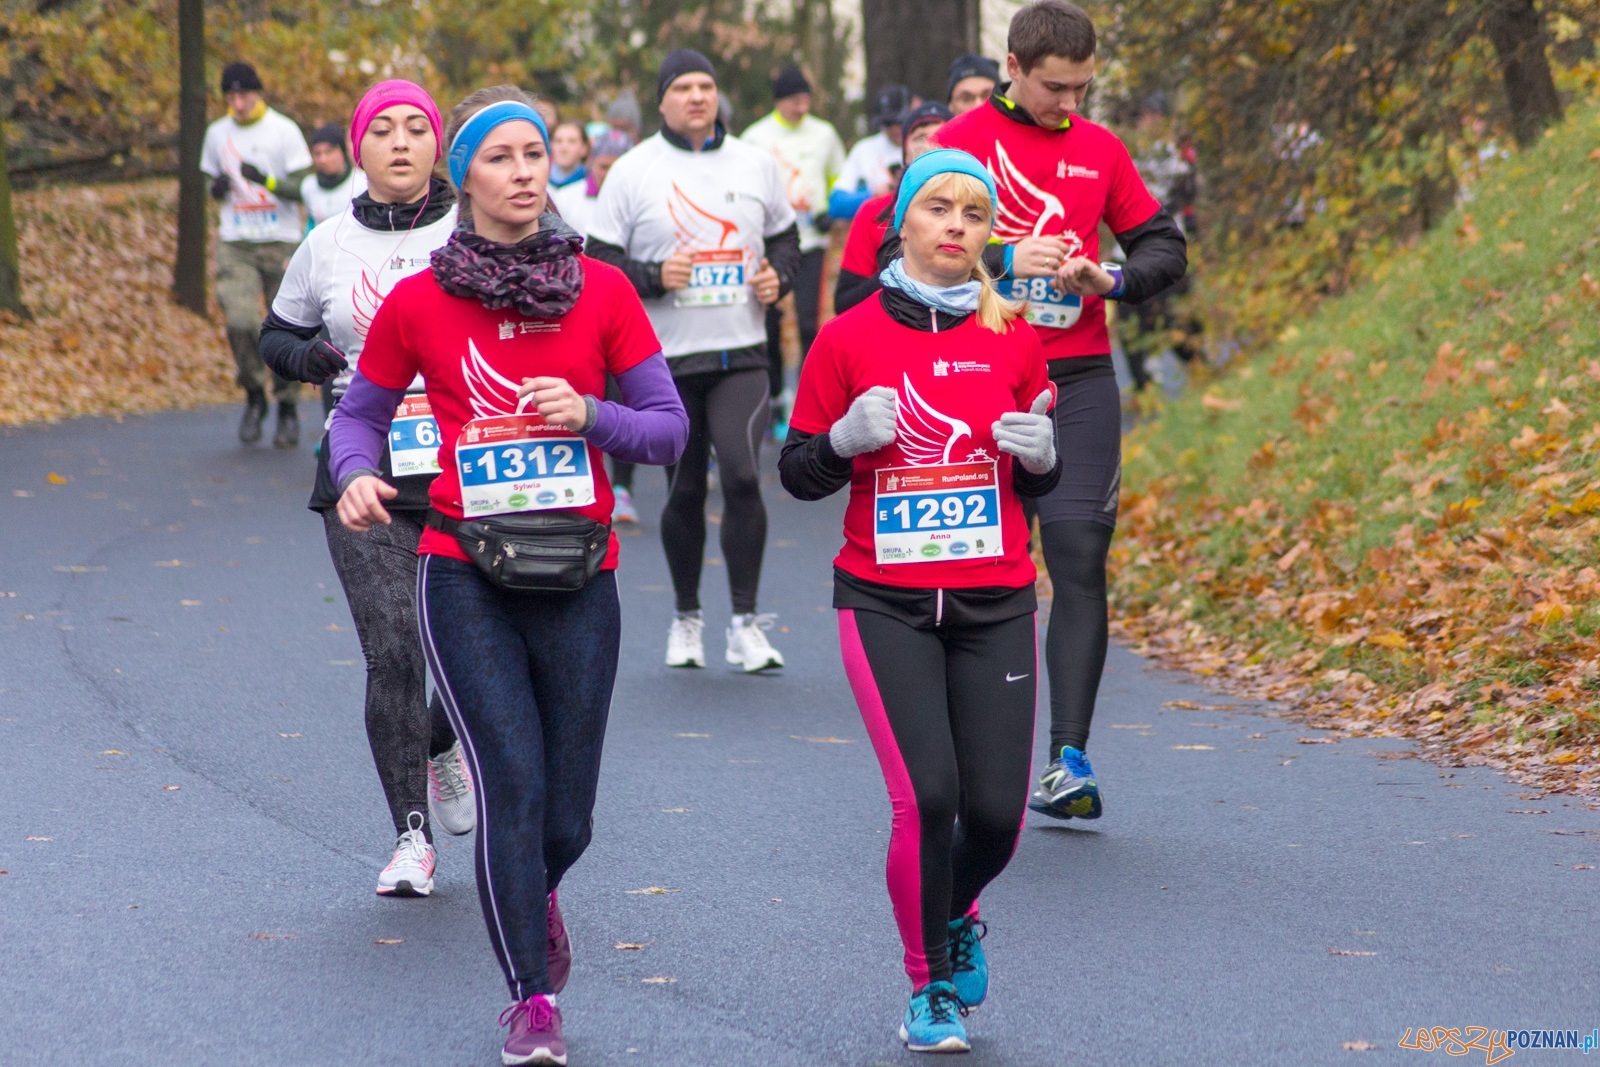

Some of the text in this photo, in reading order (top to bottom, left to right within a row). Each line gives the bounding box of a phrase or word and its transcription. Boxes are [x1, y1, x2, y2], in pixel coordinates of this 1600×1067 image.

[408, 258, 415, 267] 1
[518, 321, 527, 334] 1
[952, 361, 960, 372] 1
[393, 431, 401, 441] E
[462, 444, 576, 481] E 1312
[901, 476, 907, 487] 1
[941, 473, 989, 483] RunPoland.org
[513, 482, 541, 492] Sylwia
[879, 494, 988, 529] E 1292
[930, 533, 951, 541] Anna
